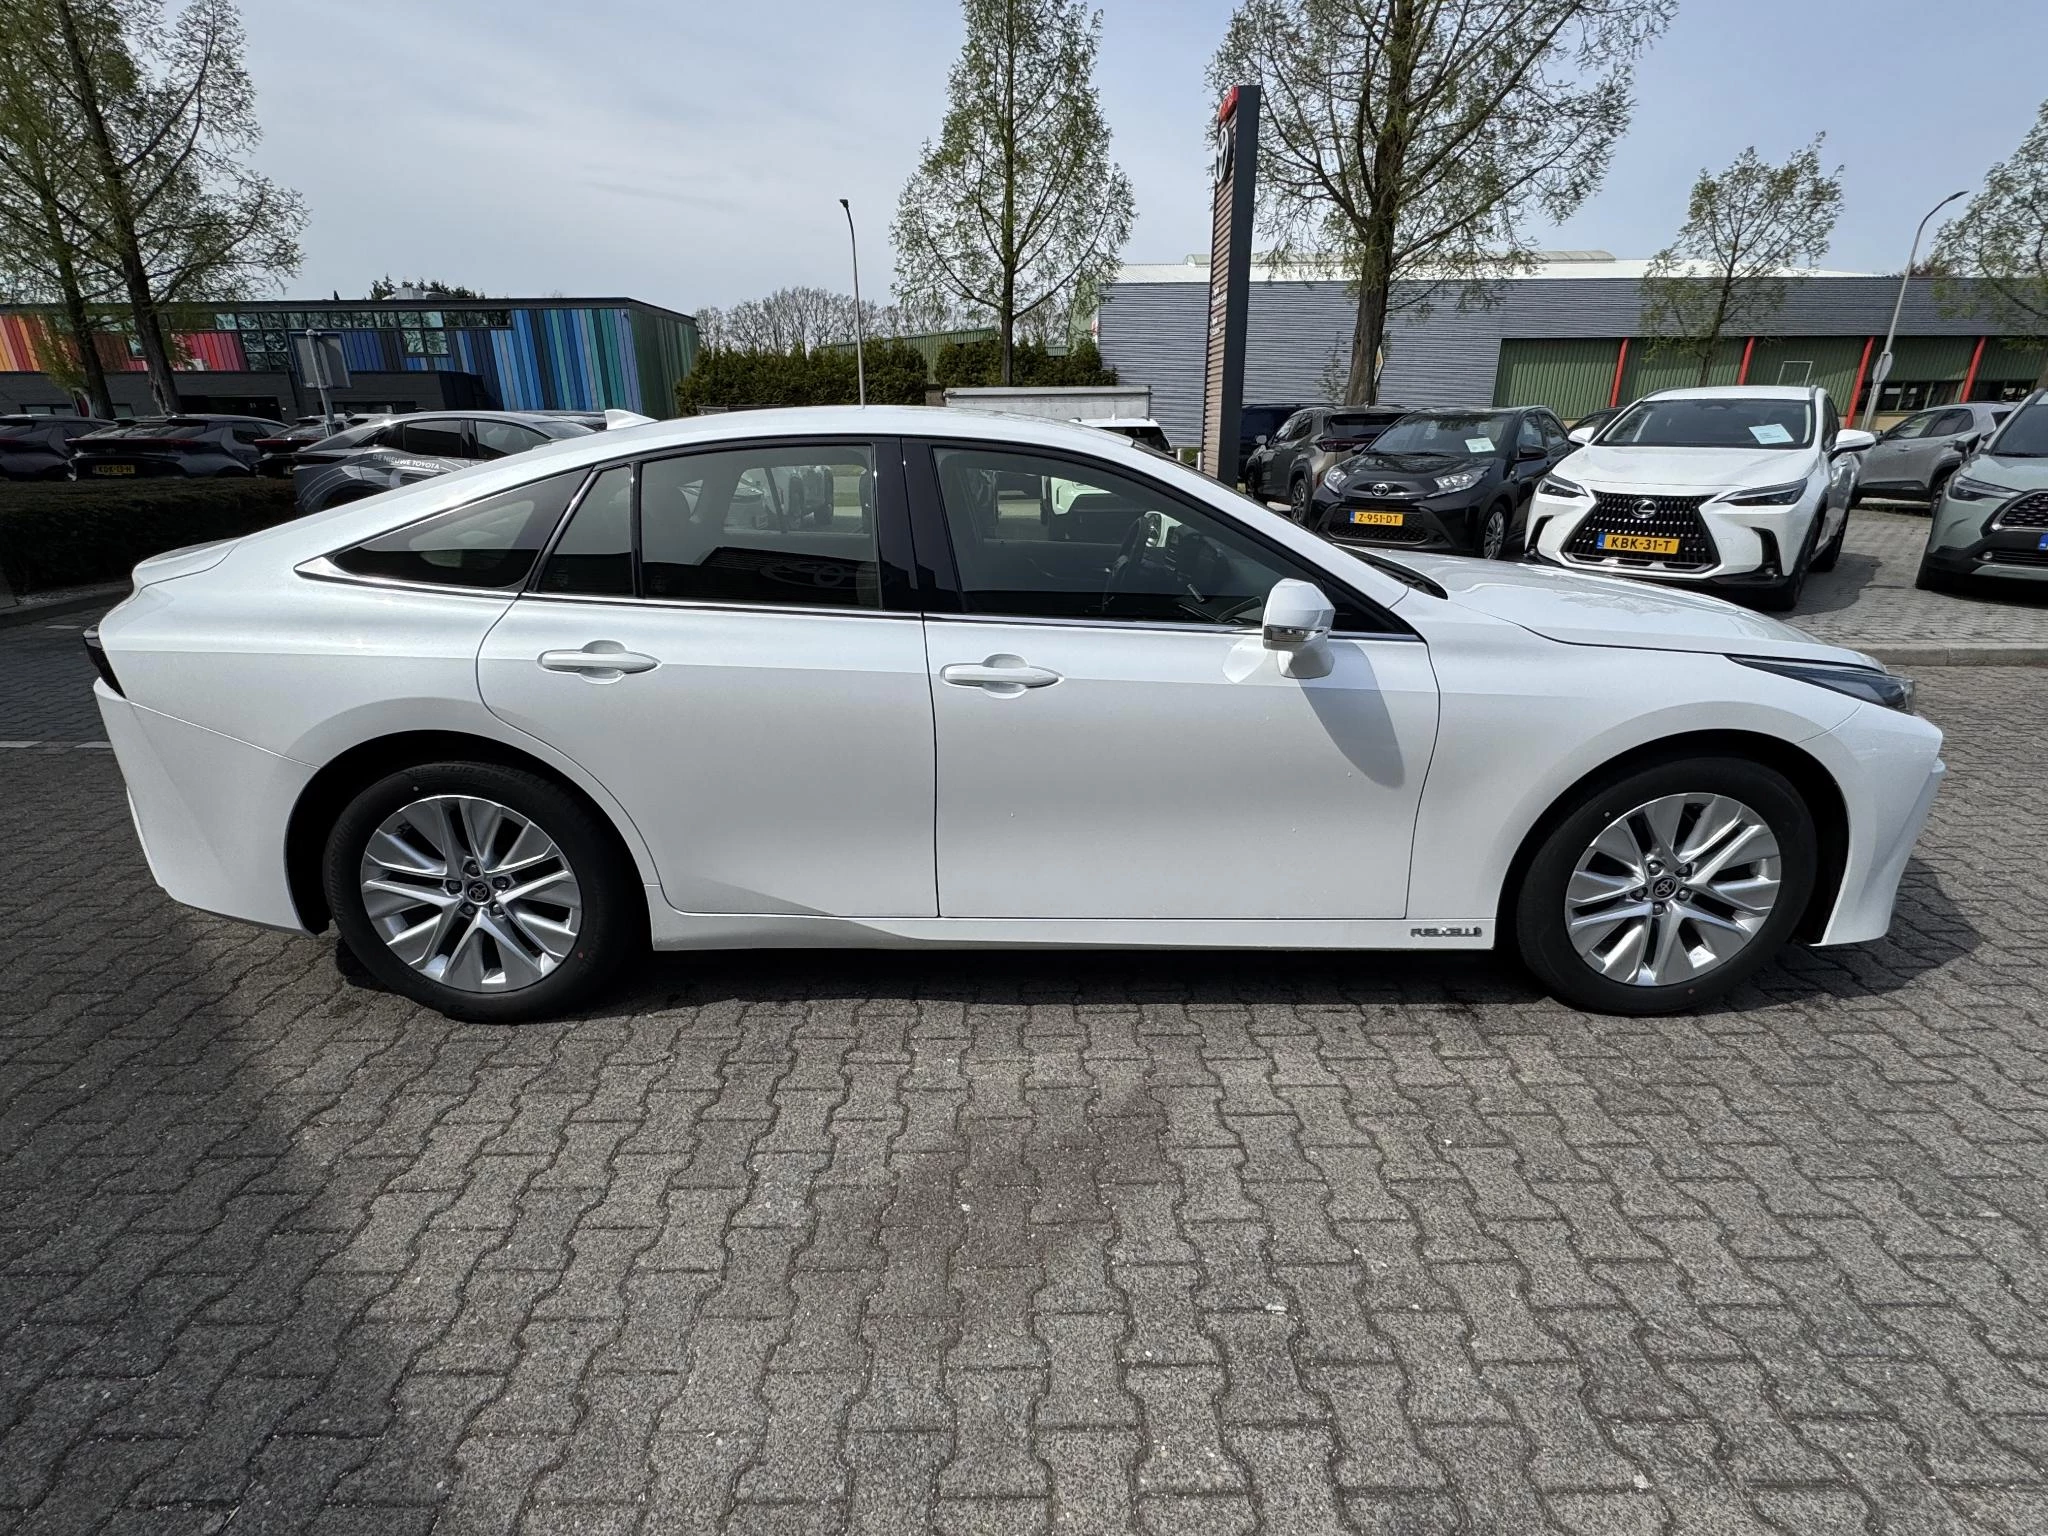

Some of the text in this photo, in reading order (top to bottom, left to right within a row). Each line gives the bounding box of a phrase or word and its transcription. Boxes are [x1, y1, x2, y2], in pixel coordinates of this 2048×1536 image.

[383, 455, 412, 466] NIEUWE
[412, 460, 440, 470] TOYOTA
[1358, 513, 1399, 524] Z-951-DT
[1610, 536, 1672, 552] KBK-31-T
